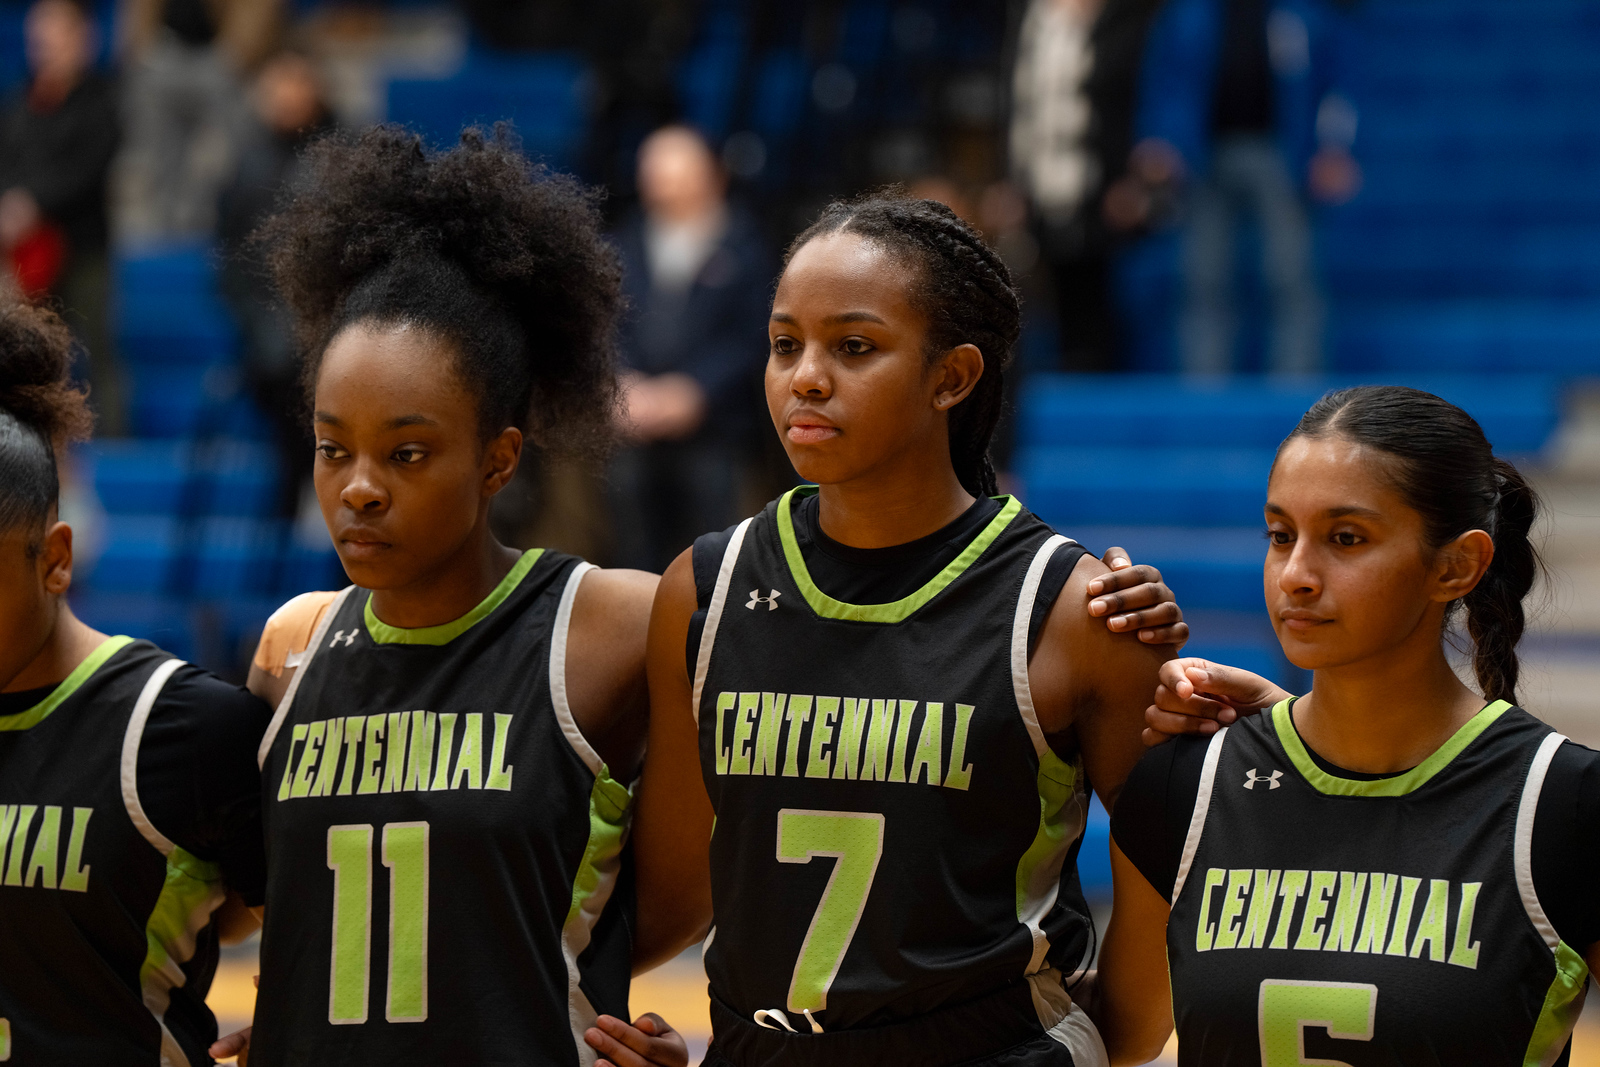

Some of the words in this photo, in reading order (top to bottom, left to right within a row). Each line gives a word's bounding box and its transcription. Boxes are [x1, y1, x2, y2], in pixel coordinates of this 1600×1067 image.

[277, 709, 514, 802] CENTENNIAL
[714, 691, 976, 791] CENTENNIAL
[326, 820, 430, 1026] 11
[775, 808, 886, 1014] 7
[1196, 867, 1483, 970] CENTENNIAL
